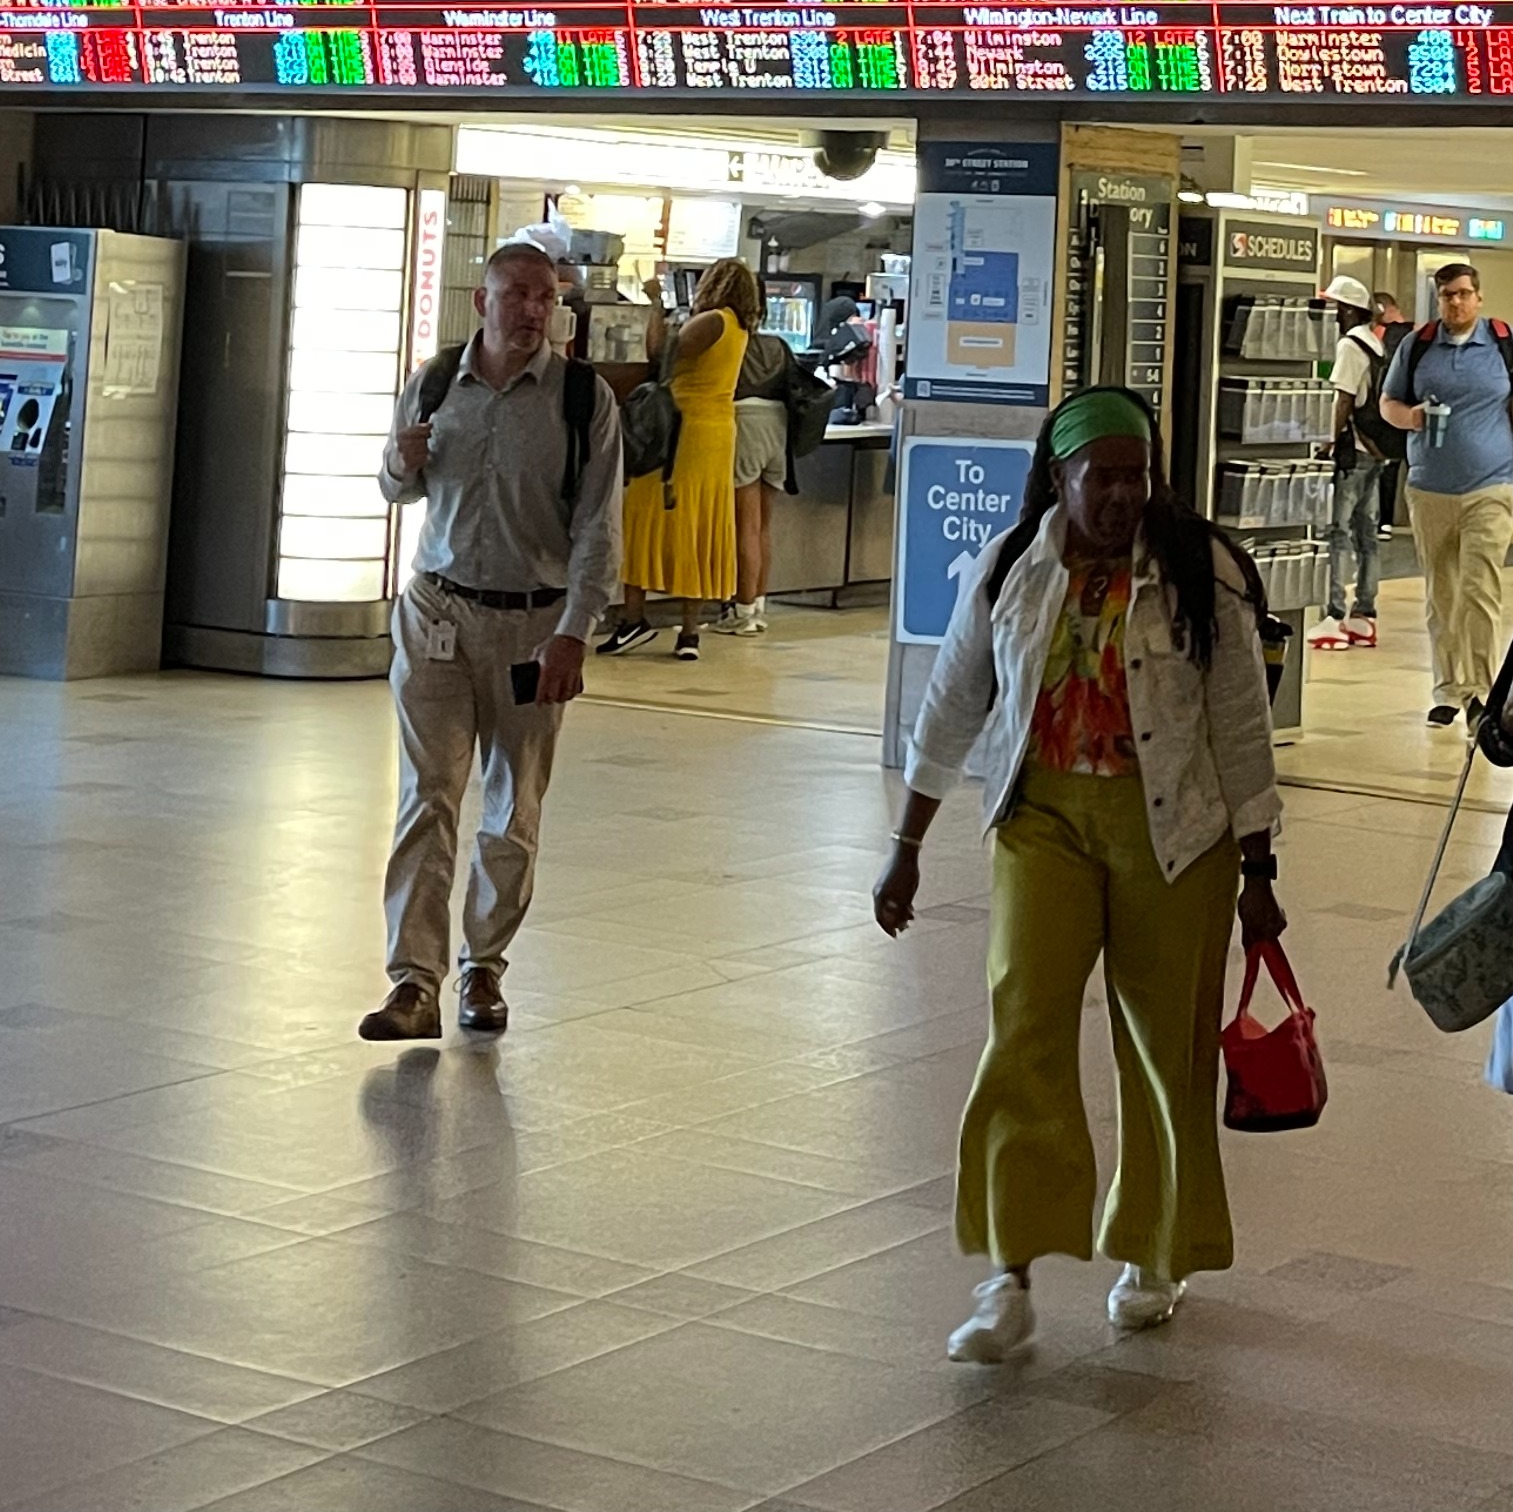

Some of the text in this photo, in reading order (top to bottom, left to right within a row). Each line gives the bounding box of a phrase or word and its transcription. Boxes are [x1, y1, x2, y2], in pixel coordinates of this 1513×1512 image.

[262, 10, 294, 27] Line
[524, 10, 556, 26] Line
[700, 9, 836, 26] West Trenton Line
[1121, 8, 1158, 25] Line
[1274, 4, 1493, 27] Next Train to Center City
[1098, 177, 1146, 202] Station
[1248, 236, 1312, 262] SCHEDULES
[418, 210, 438, 338] DONUTS
[955, 460, 985, 484] To
[927, 484, 1011, 513] Center
[942, 516, 992, 548] City
